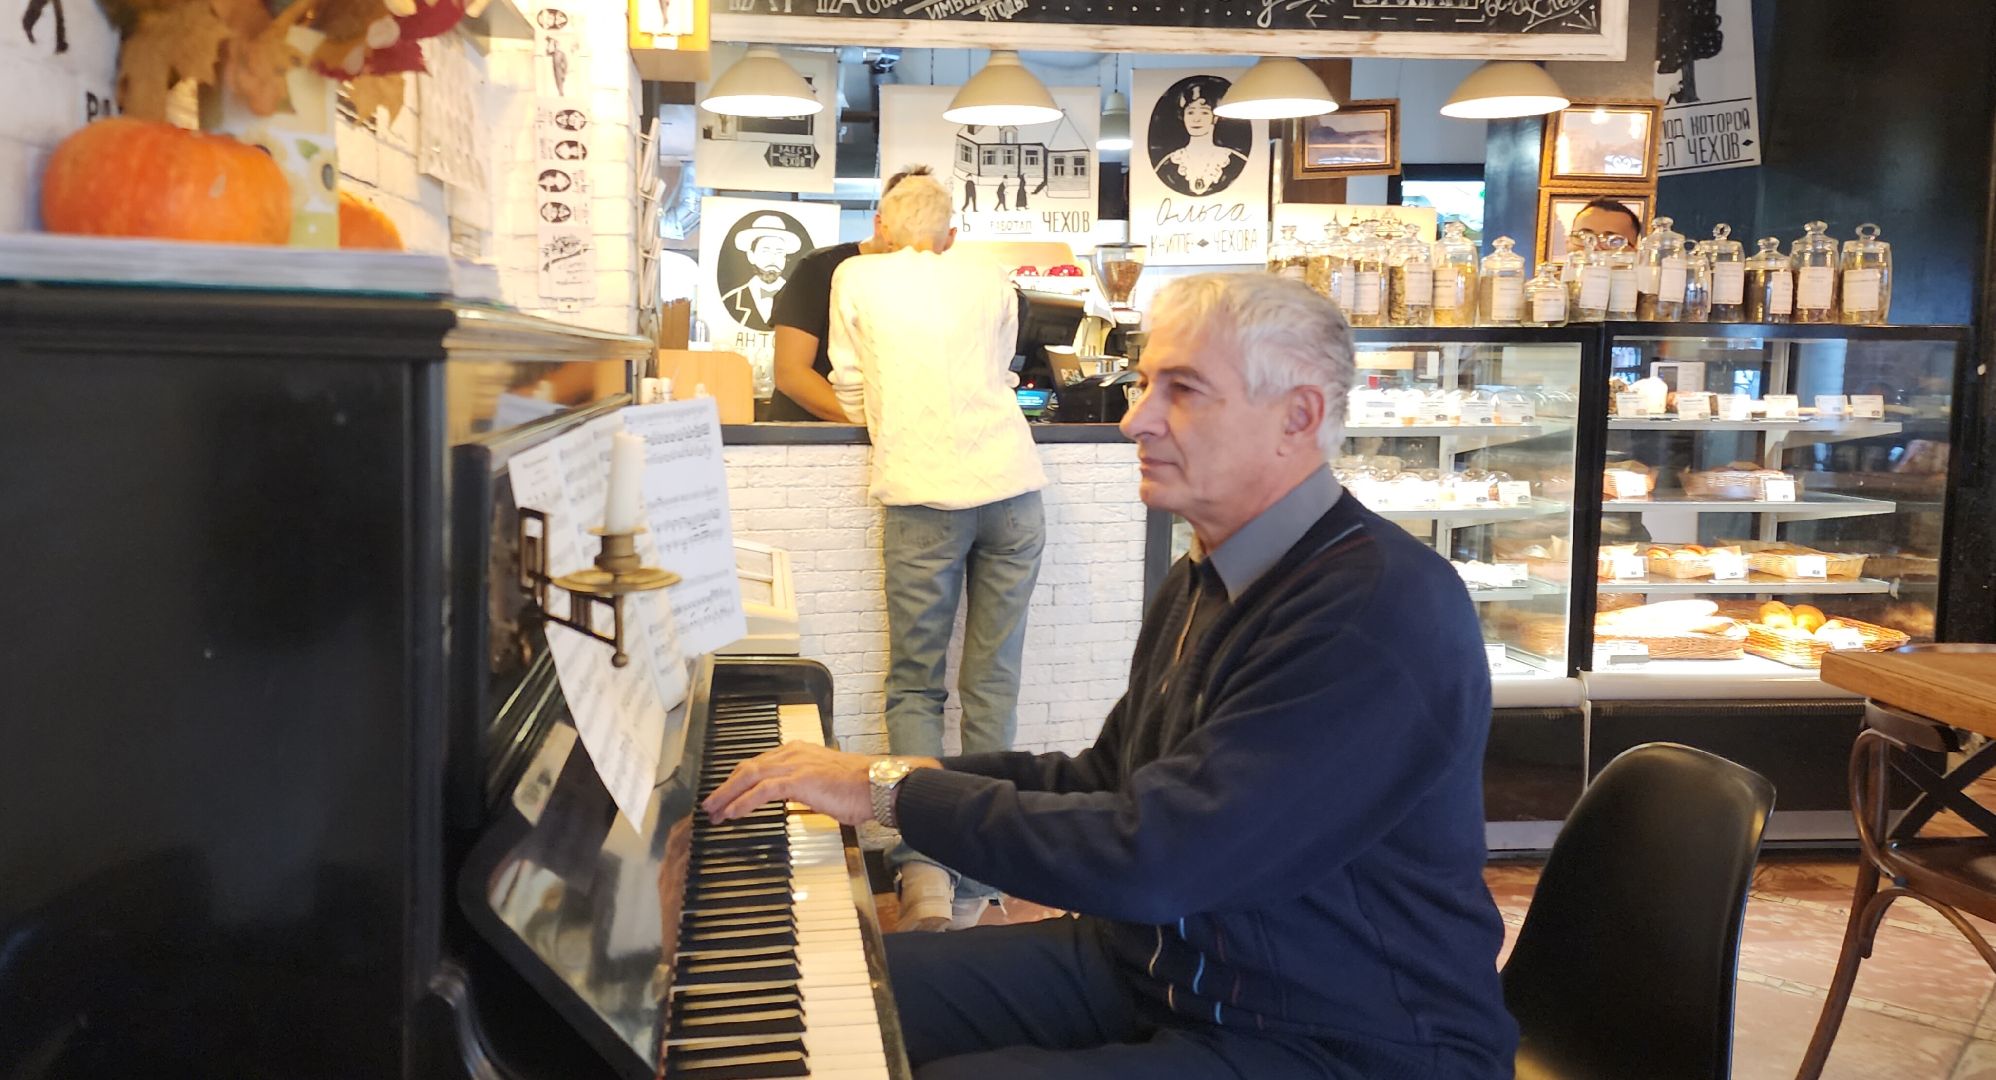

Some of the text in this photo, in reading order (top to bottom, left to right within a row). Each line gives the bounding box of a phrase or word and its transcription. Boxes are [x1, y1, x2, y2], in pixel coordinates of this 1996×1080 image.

[1690, 108, 1751, 136] КОТОРОЙ
[1687, 132, 1741, 164] ЧЕХОВ
[1043, 211, 1091, 233] ЧЕХОВ
[1157, 198, 1251, 225] Ольга
[736, 331, 776, 348] АНТ
